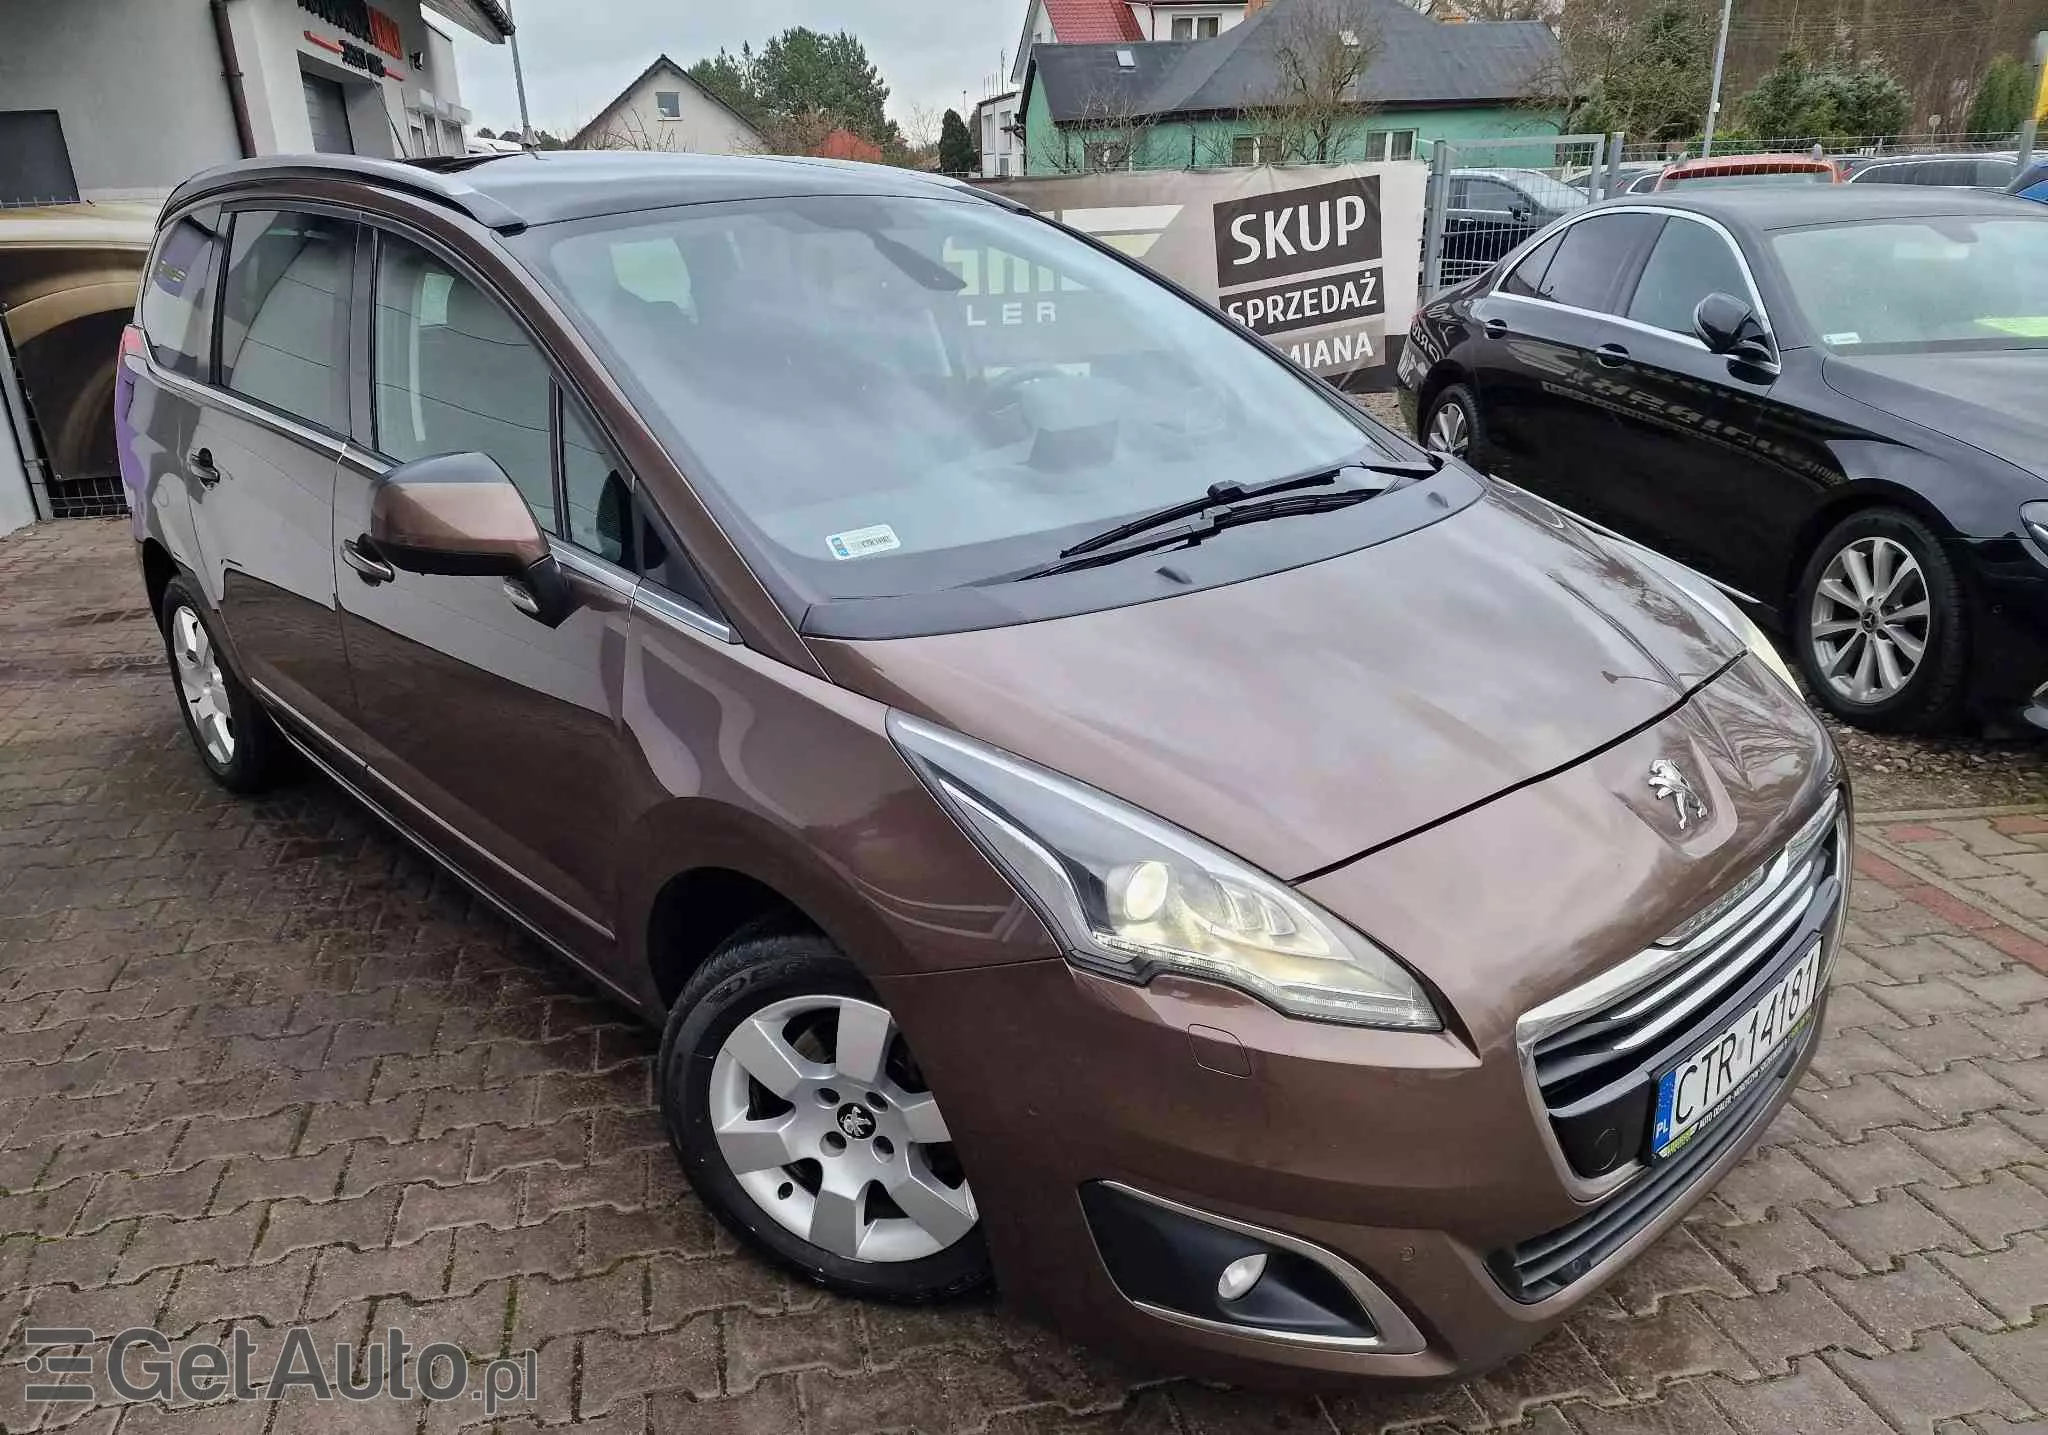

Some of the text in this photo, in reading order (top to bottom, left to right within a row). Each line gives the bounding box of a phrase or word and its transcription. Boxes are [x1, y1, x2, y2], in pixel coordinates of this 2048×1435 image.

[1231, 195, 1366, 265] SKUP
[966, 302, 1056, 326] LER
[1227, 271, 1377, 327] SPRZEDAŻ
[1279, 331, 1374, 369] MIANA
[1676, 953, 1815, 1124] CTR 14181
[1656, 1119, 1669, 1138] PL
